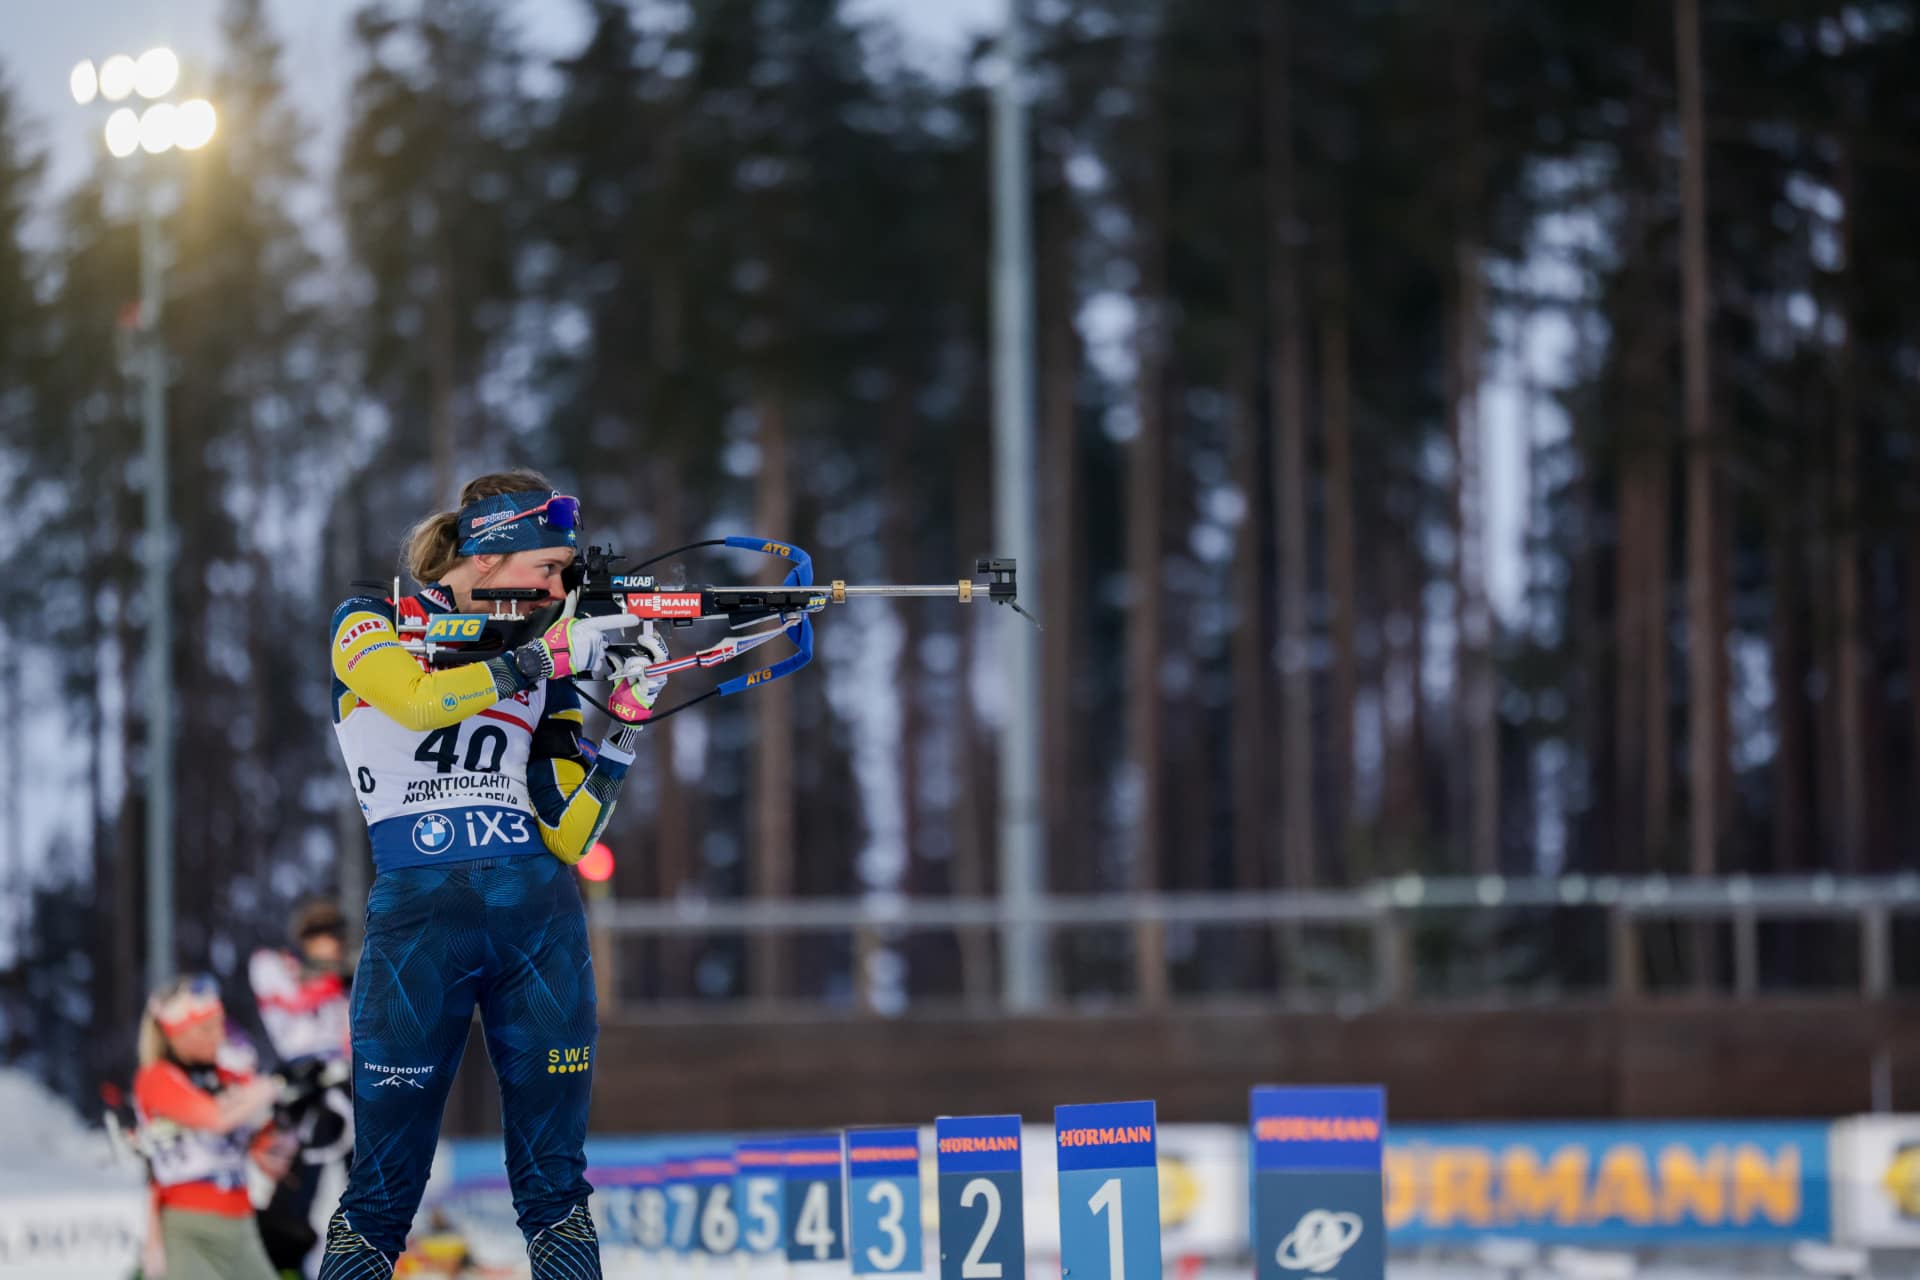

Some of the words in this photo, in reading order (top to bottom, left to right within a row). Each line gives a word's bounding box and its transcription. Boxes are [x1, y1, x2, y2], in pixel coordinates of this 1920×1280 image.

[761, 543, 791, 557] ATG
[630, 595, 699, 612] VIESSMANN
[428, 618, 481, 637] ATG
[746, 668, 773, 685] ATG
[414, 722, 508, 774] 40
[407, 775, 510, 793] KONTIOLAHTI
[465, 811, 530, 847] iX3
[364, 1062, 434, 1074] SWEDEMOUNT
[548, 1046, 590, 1063] SWE
[701, 1183, 739, 1253] 6
[745, 1176, 780, 1250] 5
[794, 1180, 835, 1260] 4
[866, 1181, 907, 1270] 3
[960, 1178, 1002, 1279] 2
[1088, 1178, 1125, 1280] 1
